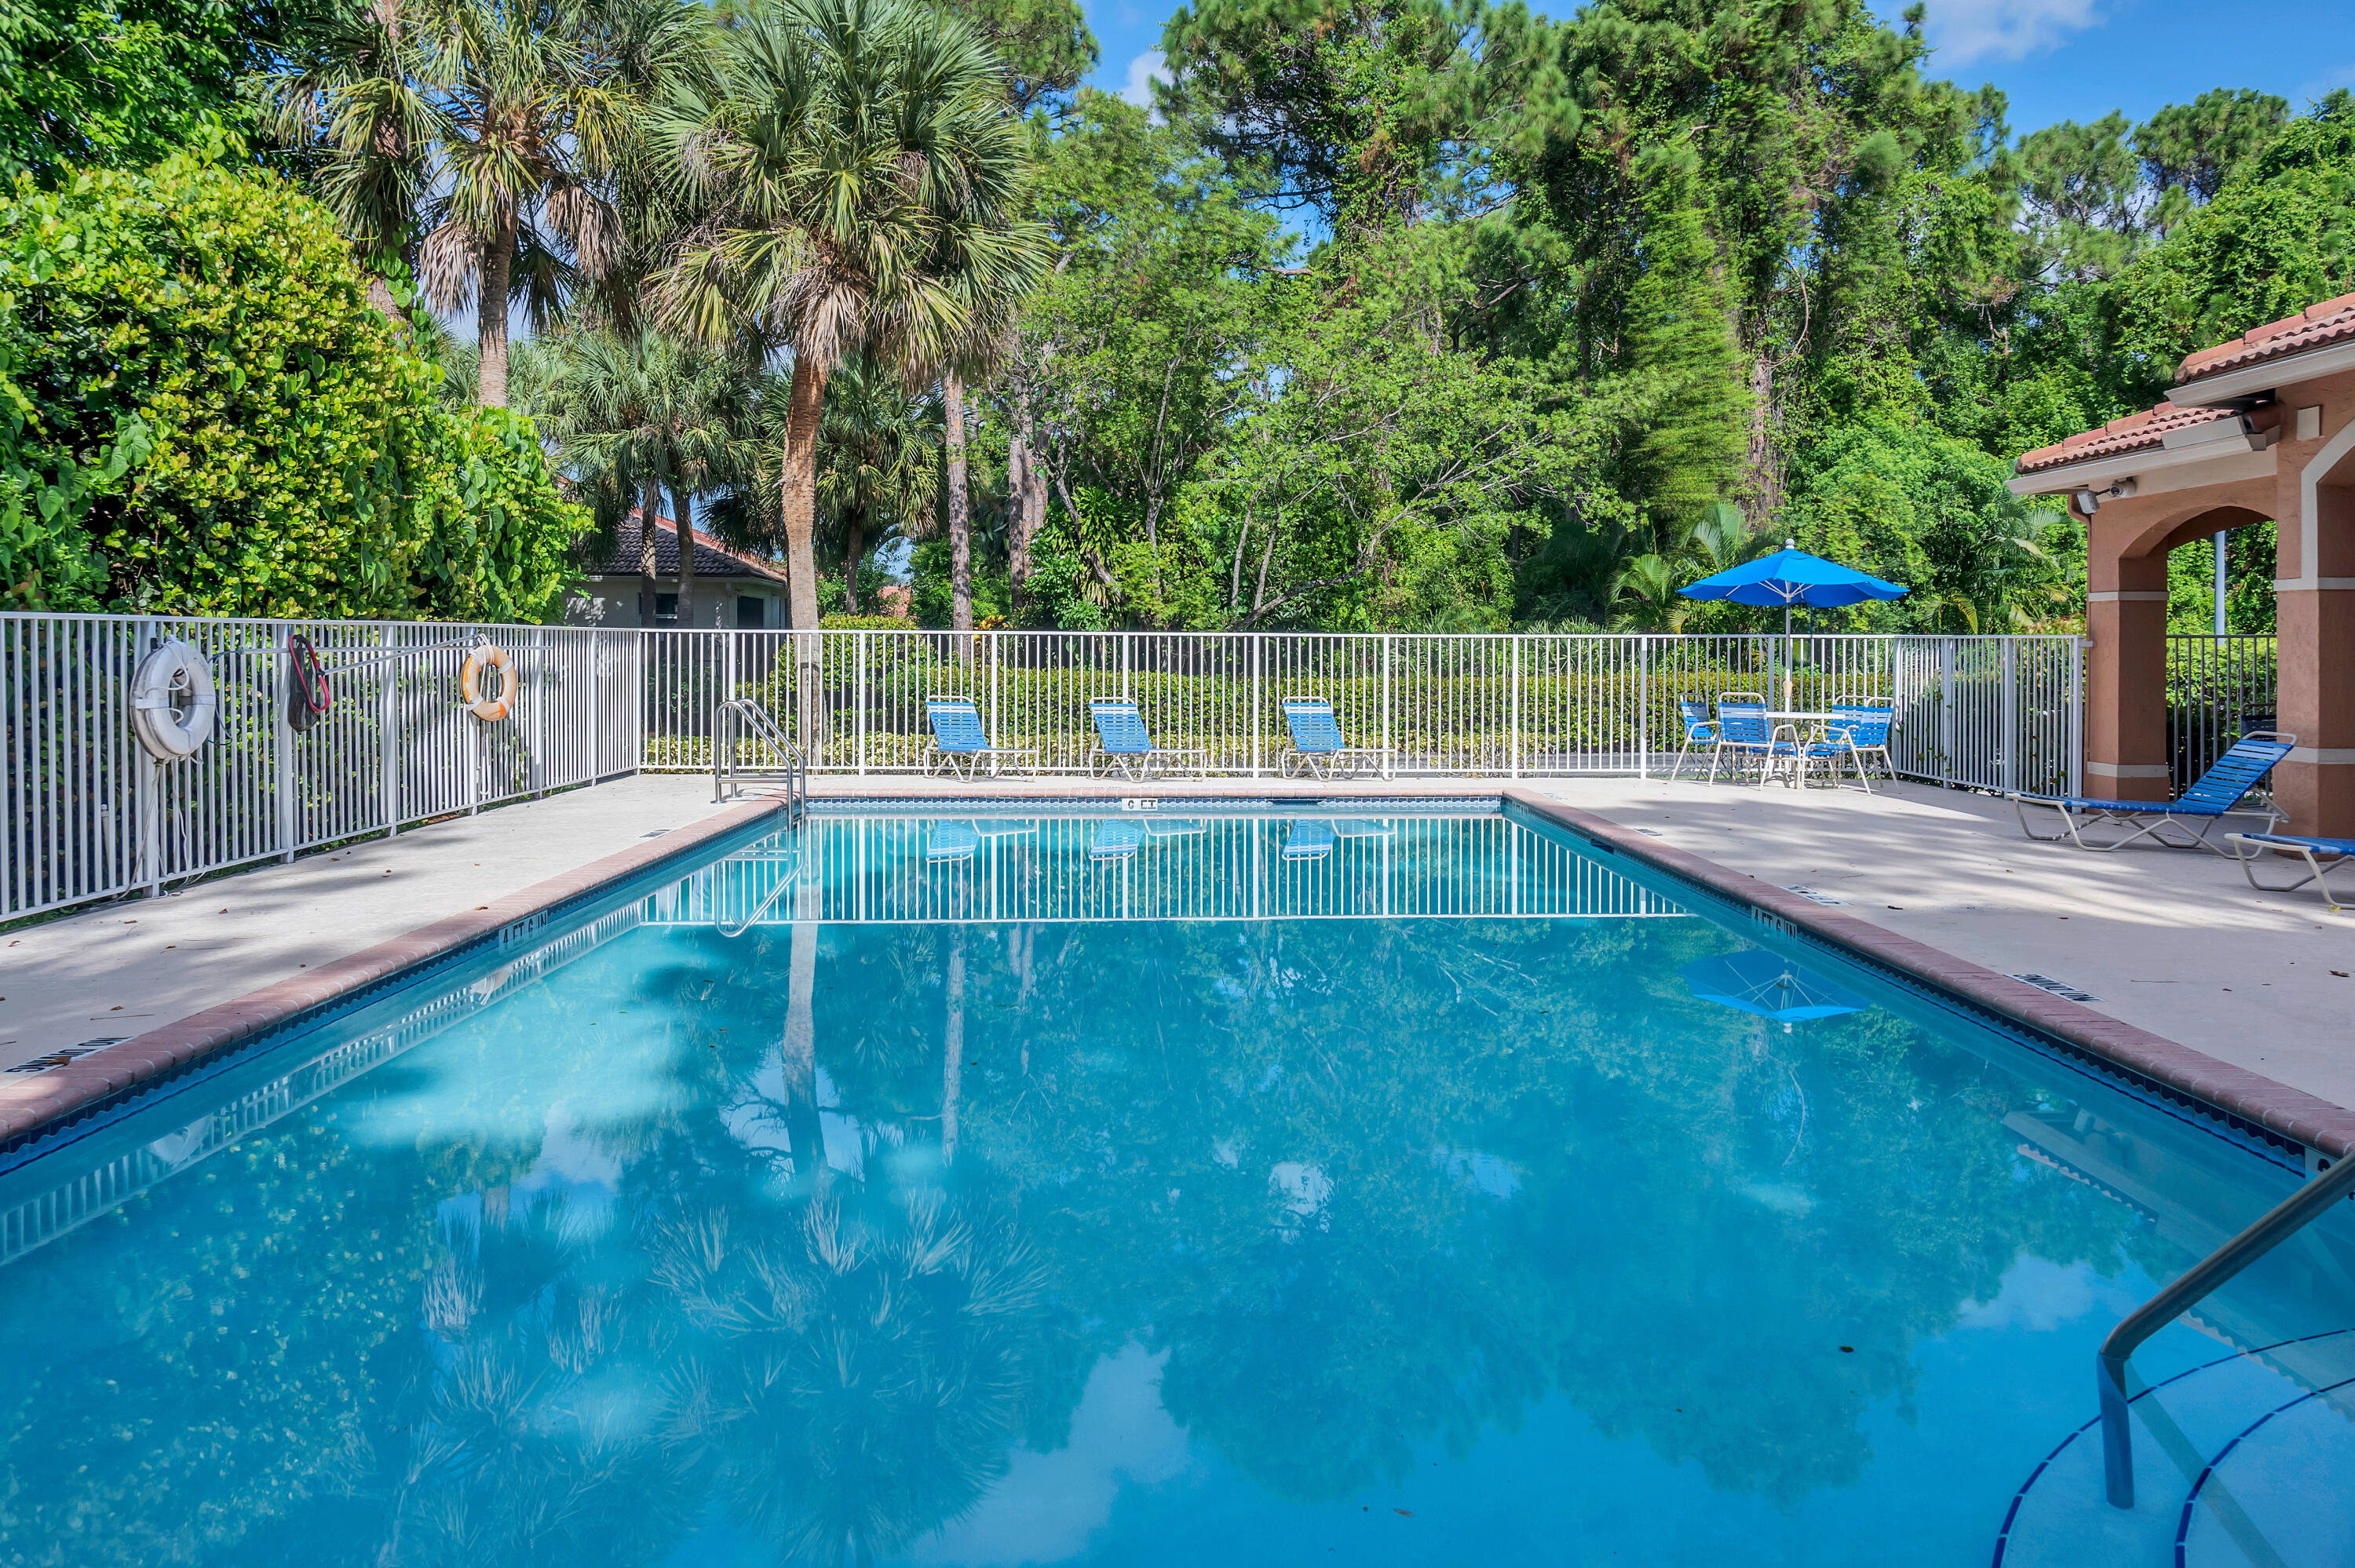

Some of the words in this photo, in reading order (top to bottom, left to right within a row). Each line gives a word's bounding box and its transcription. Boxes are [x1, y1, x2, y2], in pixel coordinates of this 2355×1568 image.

[513, 921, 524, 940] FT
[537, 912, 547, 929] IN
[1762, 912, 1773, 929] FT
[1785, 921, 1796, 939] IN
[2012, 974, 2075, 990] DIVING
[2058, 992, 2103, 1001] NO
[78, 1036, 133, 1046] NO
